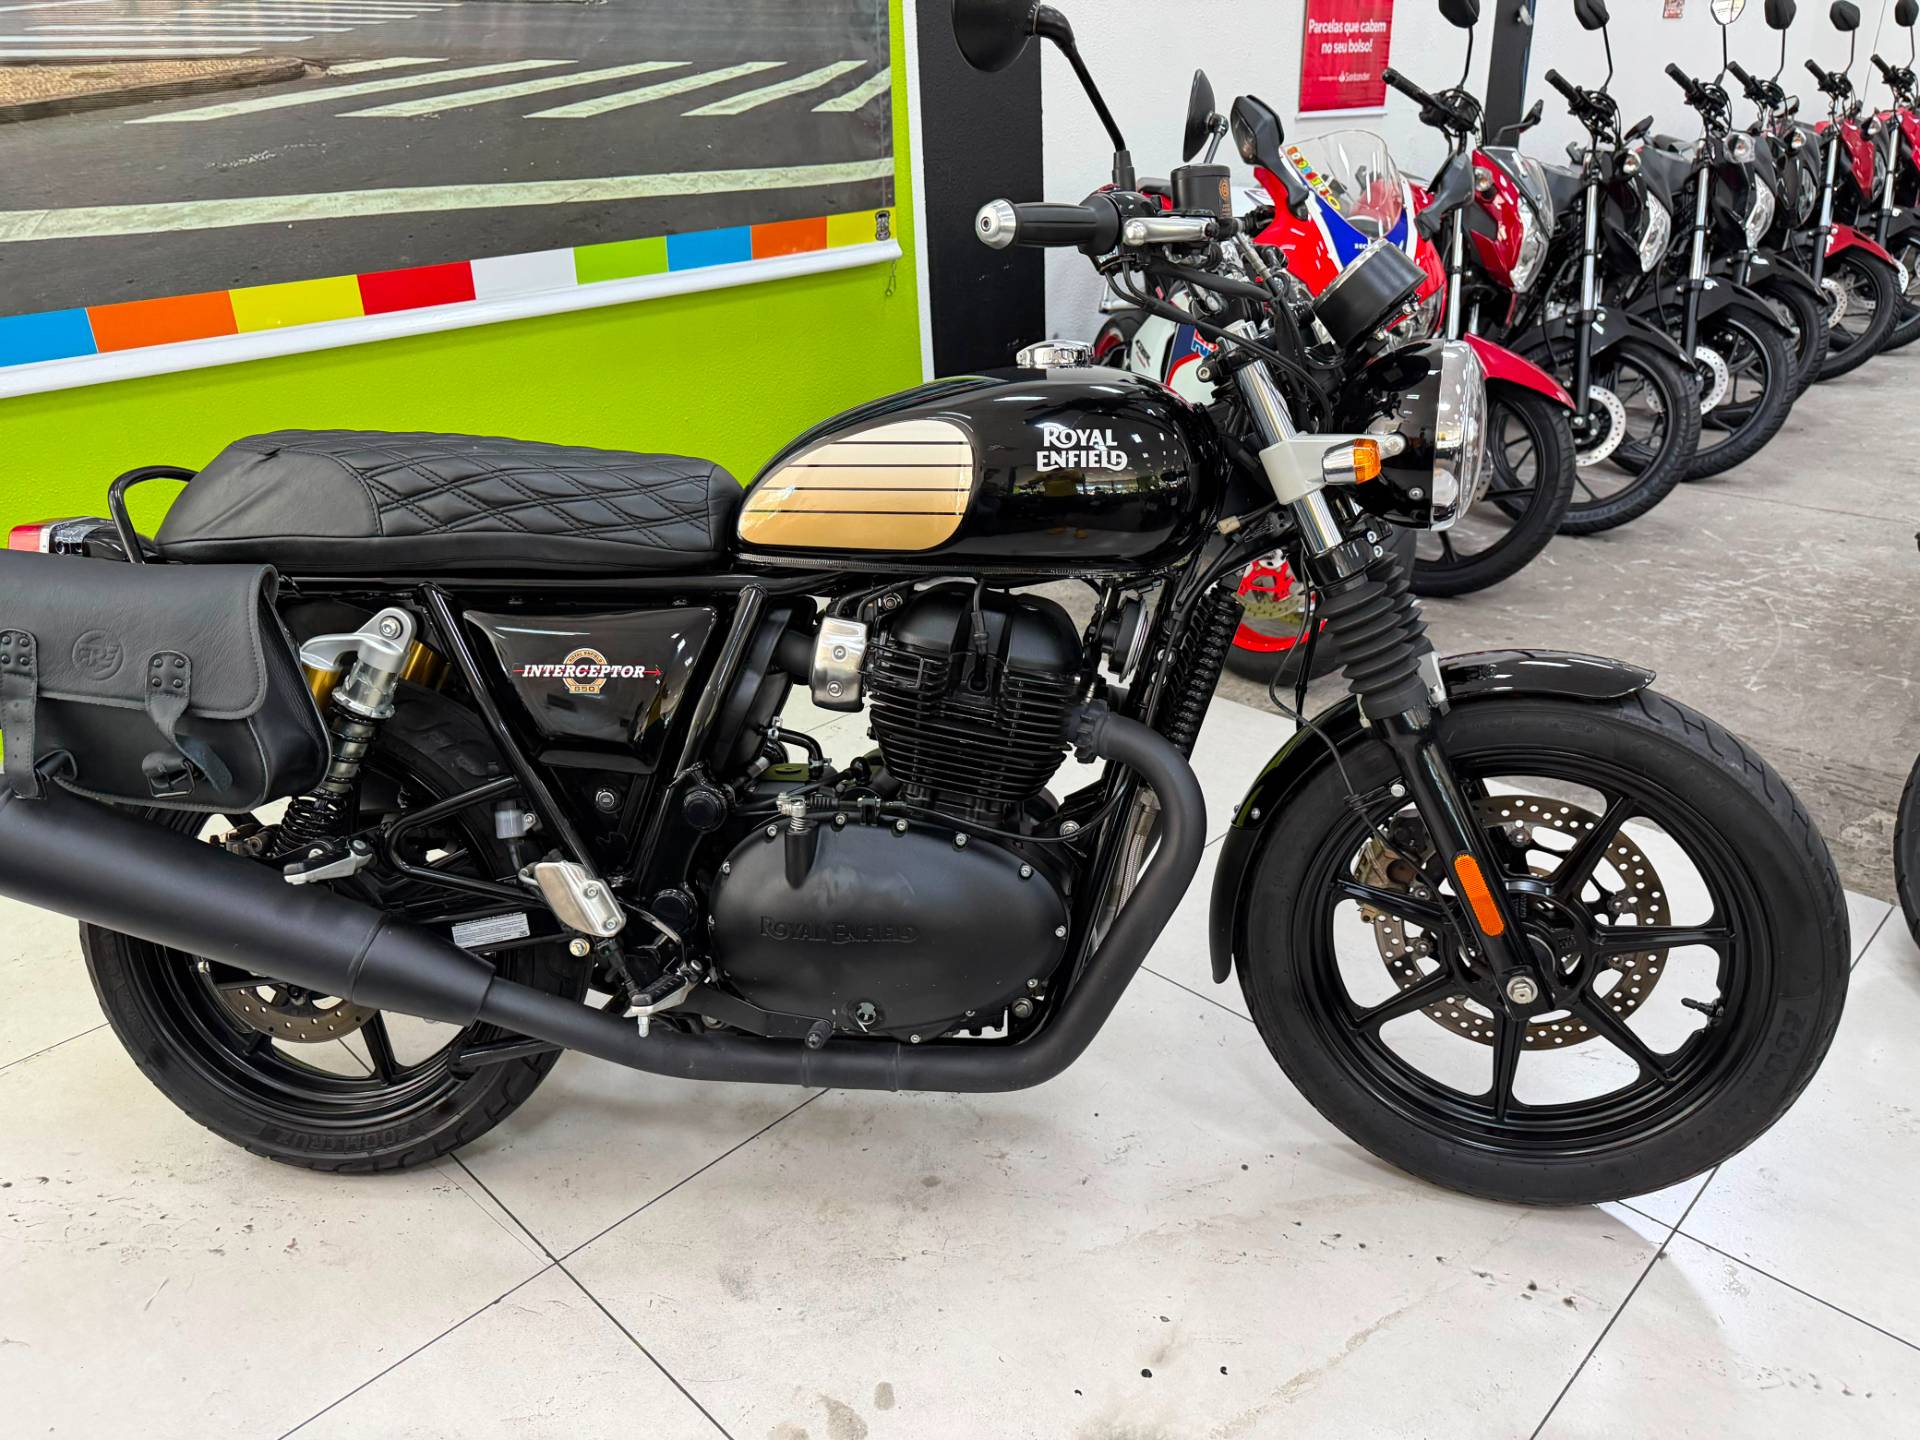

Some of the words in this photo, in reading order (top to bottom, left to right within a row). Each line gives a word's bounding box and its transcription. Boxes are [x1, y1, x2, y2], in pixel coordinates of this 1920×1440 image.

[1308, 18, 1343, 34] Parcelas
[1344, 21, 1360, 37] que
[1360, 18, 1387, 33] cabem
[1321, 42, 1333, 54] no
[1333, 42, 1348, 53] seu
[1348, 38, 1373, 52] bolso!
[1345, 72, 1371, 81] Santander
[1043, 426, 1118, 449] ROYAL
[1036, 450, 1128, 472] ENFIELD
[522, 664, 645, 678] INTERCEPTOR
